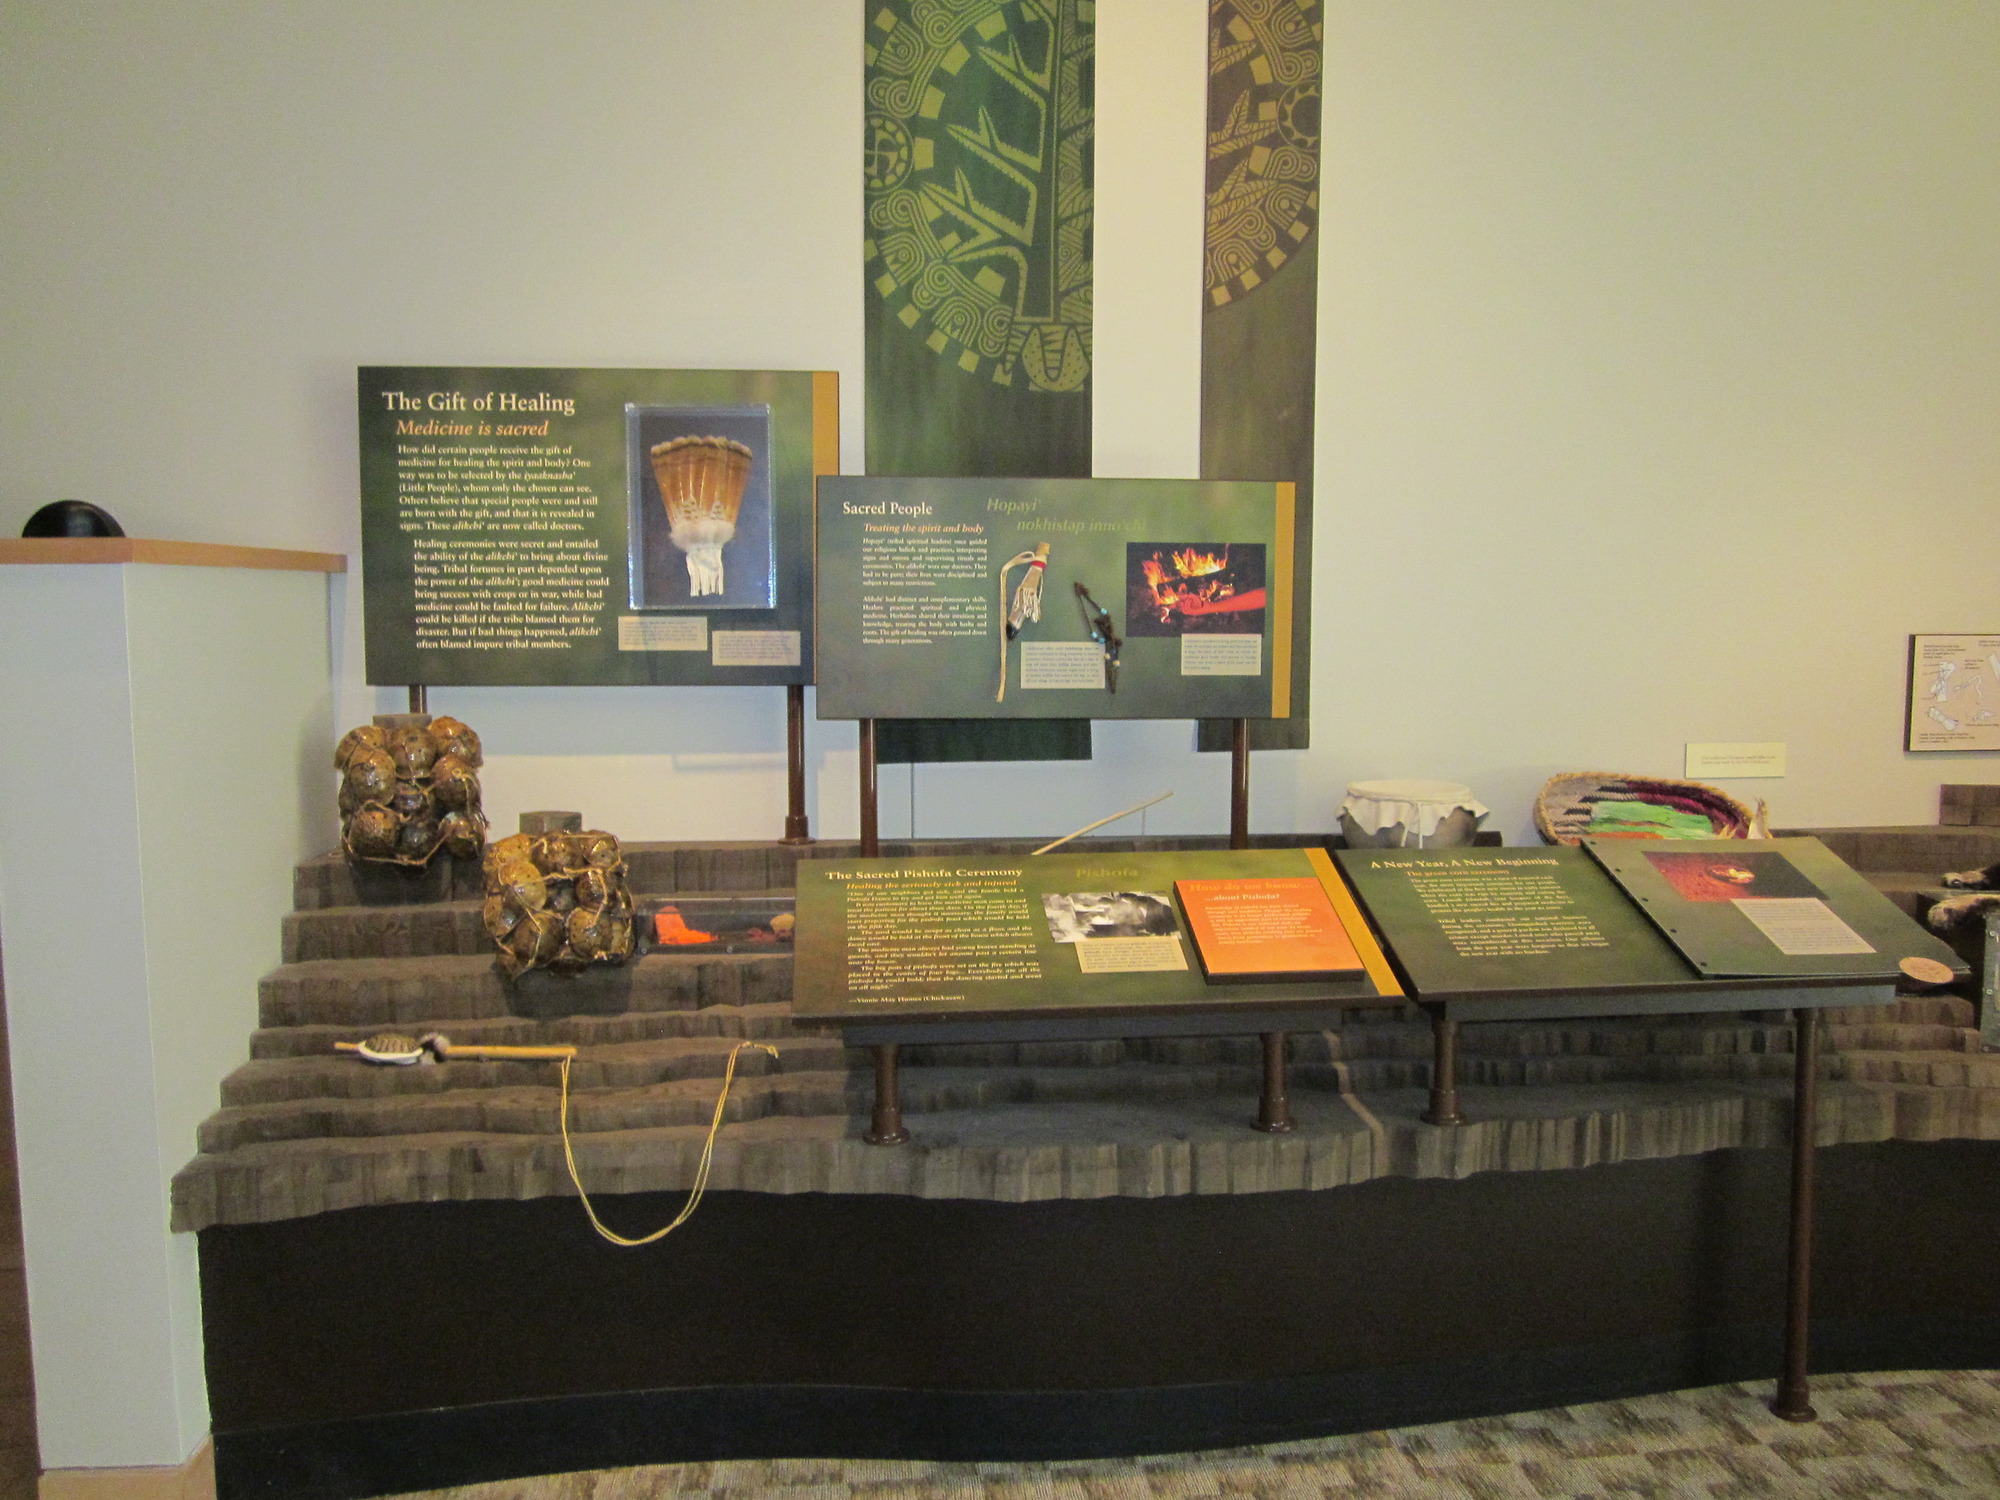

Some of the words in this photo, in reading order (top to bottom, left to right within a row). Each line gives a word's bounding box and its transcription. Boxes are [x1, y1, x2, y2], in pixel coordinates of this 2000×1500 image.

[382, 392, 422, 412] The
[428, 392, 467, 411] Gift
[472, 392, 494, 412] of
[499, 392, 576, 417] Healing
[396, 420, 472, 436] Medicine
[478, 420, 491, 436] is
[496, 420, 549, 436] sacred
[398, 445, 418, 453] How
[421, 445, 435, 453] did
[437, 445, 467, 453] certain
[469, 445, 497, 456] people
[499, 445, 528, 453] receive
[530, 445, 544, 453] the
[545, 445, 560, 456] gift
[562, 445, 571, 453] of
[398, 458, 435, 466] medicine
[438, 458, 450, 466] for
[453, 458, 484, 469] healing
[486, 458, 500, 466] the
[502, 458, 523, 469] spirit
[526, 458, 542, 466] and
[544, 458, 569, 469] body?
[572, 458, 591, 466] One
[399, 473, 415, 481] way
[448, 470, 458, 479] be
[460, 470, 493, 479] selected
[495, 470, 506, 481] by
[508, 470, 521, 479] the
[399, 482, 424, 494] (Little
[427, 483, 460, 494] People),
[462, 483, 489, 491] whom
[491, 483, 510, 494] only
[512, 483, 526, 491] the
[527, 483, 556, 491] chosen
[399, 495, 428, 504] Others
[430, 495, 459, 504] believe
[461, 495, 478, 504] that
[481, 495, 509, 506] special
[511, 495, 539, 506] people
[564, 495, 580, 504] and
[582, 495, 597, 504] still
[415, 508, 435, 517] born
[438, 508, 457, 517] with
[459, 508, 472, 517] the
[474, 508, 492, 519] gift,
[494, 508, 510, 517] and
[512, 508, 529, 517] that
[531, 508, 538, 517] it
[540, 508, 547, 517] is
[549, 508, 584, 517] revealed
[586, 508, 594, 517] in
[843, 501, 886, 515] Sacred
[890, 501, 932, 518] People
[400, 521, 422, 532] signs.
[427, 521, 450, 529] These
[522, 521, 548, 529] called
[549, 521, 584, 529] doctors.
[864, 523, 900, 534] Treating
[902, 523, 917, 533] the
[918, 523, 941, 534] spirit
[942, 524, 960, 533] and
[962, 523, 984, 534] body
[414, 539, 447, 550] Healing
[449, 539, 495, 547] ceremonies
[546, 539, 562, 547] and
[564, 539, 598, 547] entailed
[414, 552, 427, 560] the
[430, 552, 456, 563] ability
[458, 552, 467, 560] of
[470, 552, 483, 560] the
[530, 552, 554, 563] bring
[556, 552, 580, 560] about
[582, 552, 608, 560] divine
[414, 564, 439, 575] being.
[442, 564, 467, 573] Tribal
[470, 564, 504, 573] fortunes
[506, 564, 515, 573] in
[517, 565, 534, 575] part
[537, 564, 577, 575] depended
[579, 567, 601, 575] upon
[416, 626, 449, 635] disaster.
[452, 626, 466, 635] But
[469, 626, 475, 635] if
[478, 626, 494, 635] bad
[496, 626, 522, 638] things
[524, 626, 567, 638] happened,
[416, 639, 438, 648] often
[440, 639, 471, 648] blamed
[473, 639, 503, 650] impure
[505, 639, 528, 648] tribal
[530, 639, 571, 648] members.
[1495, 858, 1559, 866] Beginning
[825, 871, 852, 880] The
[856, 870, 899, 879] Sacred
[904, 869, 952, 878] Pishofa
[956, 869, 1022, 877] Ceremony
[1076, 867, 1138, 878] Pishofa
